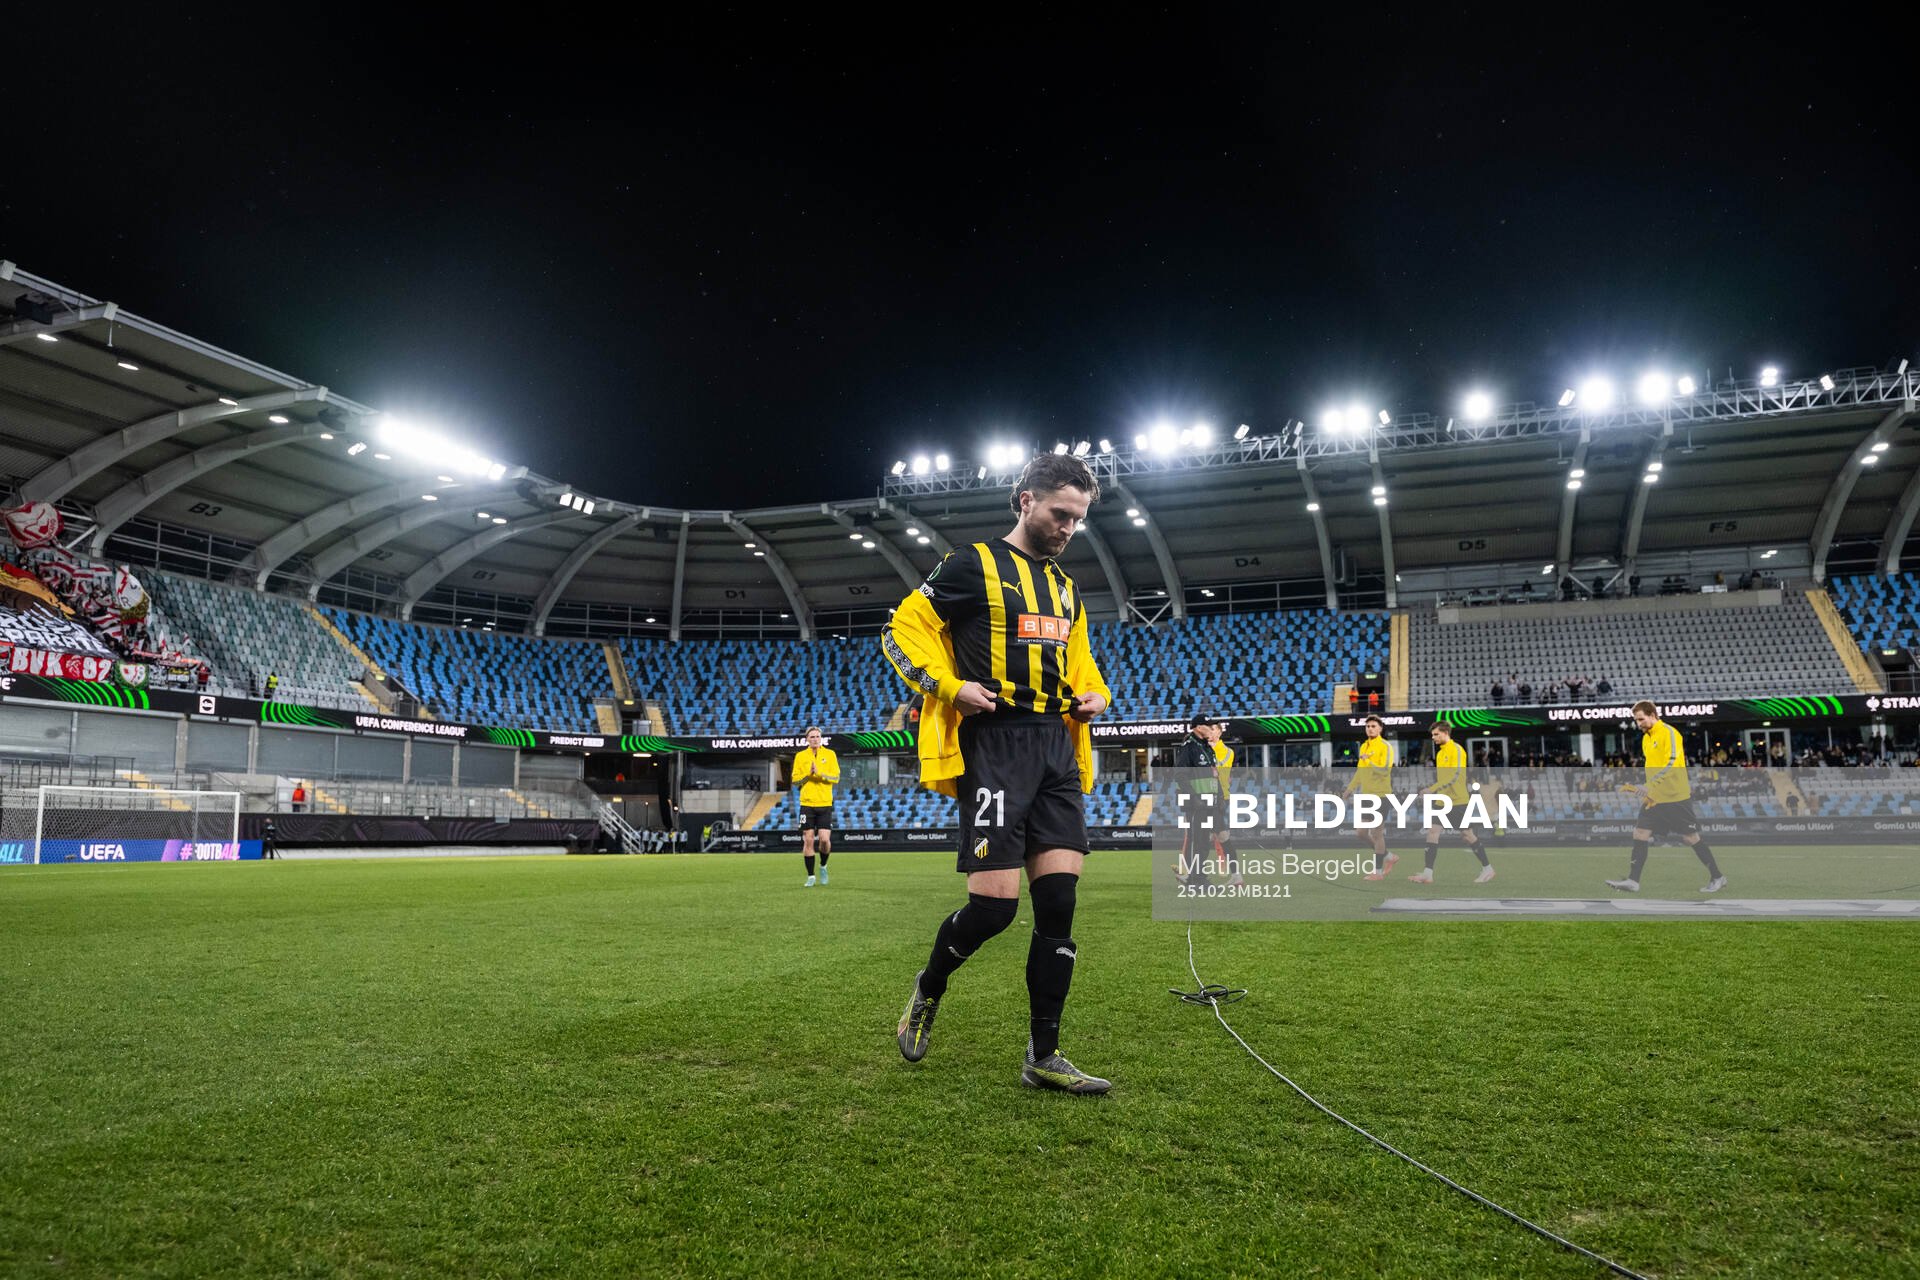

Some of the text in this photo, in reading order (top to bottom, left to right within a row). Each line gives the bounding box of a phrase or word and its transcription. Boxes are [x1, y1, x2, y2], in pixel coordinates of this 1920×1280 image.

[188, 502, 223, 517] B3
[1708, 520, 1738, 533] F5
[1458, 539, 1487, 552] D5
[1234, 556, 1262, 568] D4
[724, 590, 746, 600] D1
[848, 586, 872, 596] D2
[1024, 620, 1069, 635] BRA
[12, 647, 113, 682] BVK 92
[1549, 704, 1714, 720] UEFA CONFERE LEAGUE
[355, 715, 466, 737] UEFA CONFERENCE LEAGUE
[1092, 726, 1119, 736] UEFA
[1120, 724, 1185, 735] CONFERENCE
[550, 736, 583, 746] PREDICT
[712, 739, 738, 749] UEFA
[739, 738, 794, 748] CONFERENCE
[975, 787, 1004, 827] 21
[81, 844, 125, 860] UEFA
